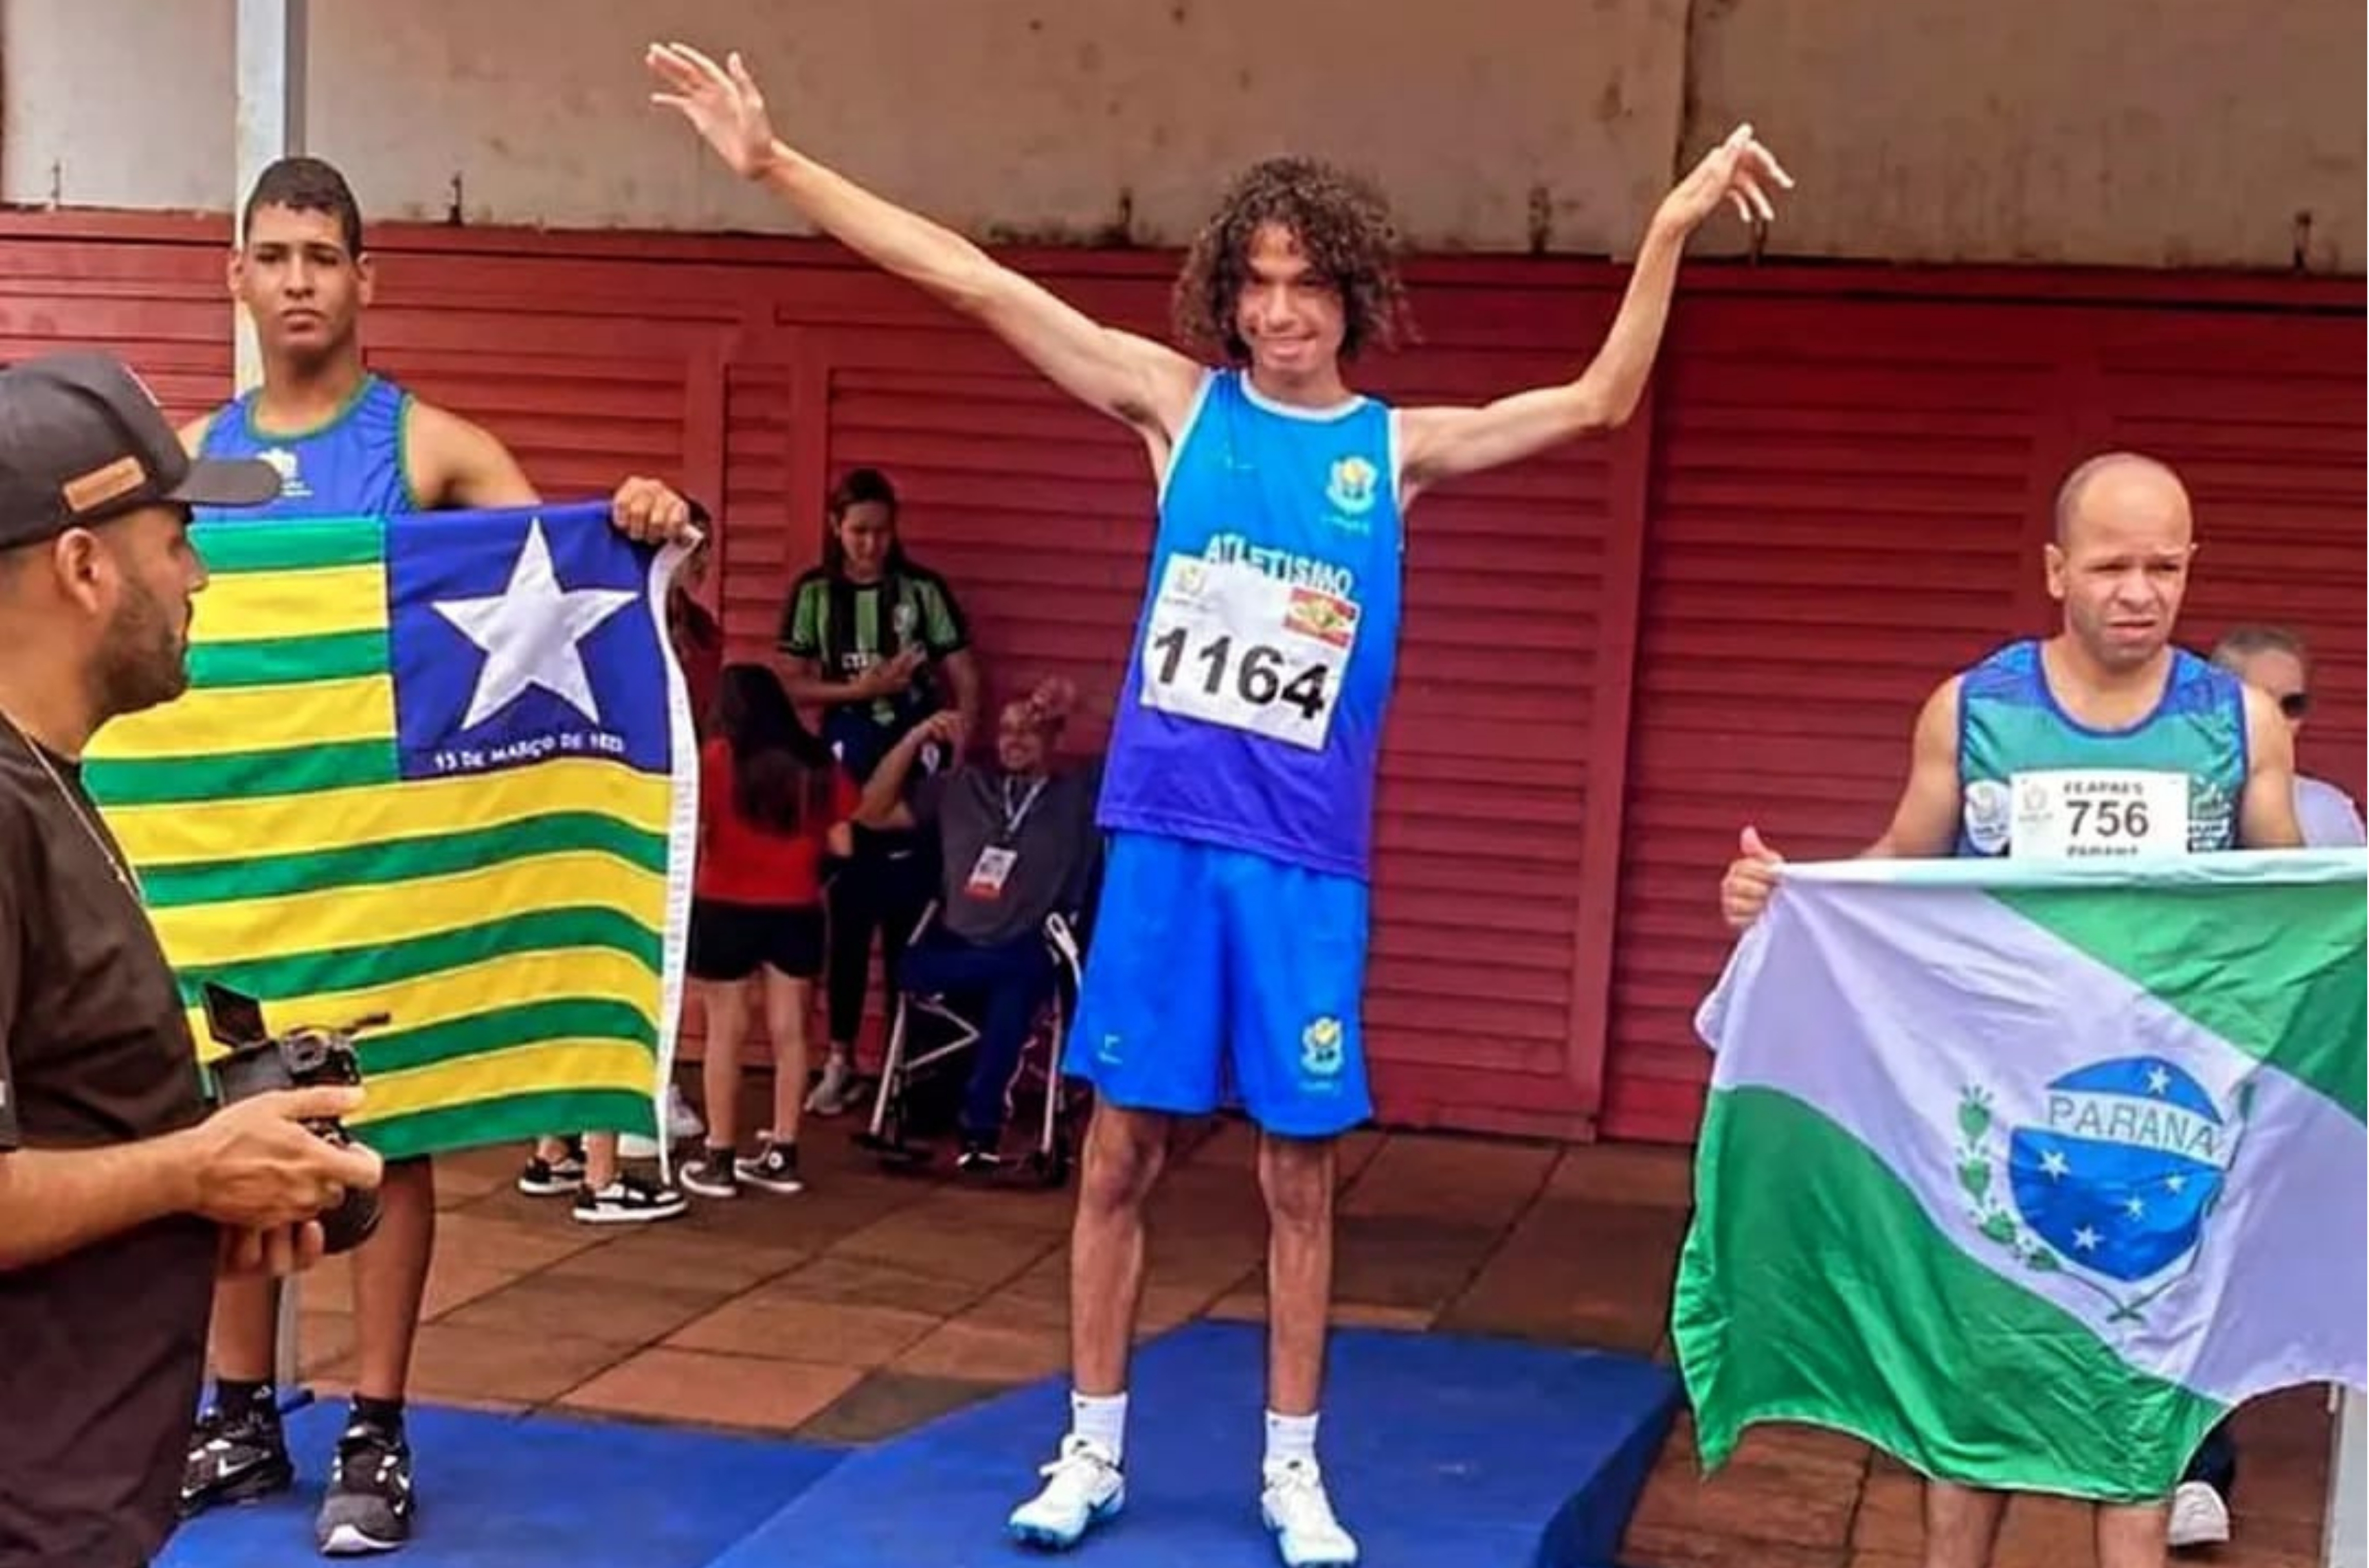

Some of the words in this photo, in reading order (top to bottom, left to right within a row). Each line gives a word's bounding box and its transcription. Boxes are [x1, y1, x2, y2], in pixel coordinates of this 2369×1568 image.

[1204, 533, 1353, 597] ATLETISMO
[1154, 627, 1329, 720] 1164
[560, 732, 582, 750] DE
[2065, 800, 2149, 838] 756
